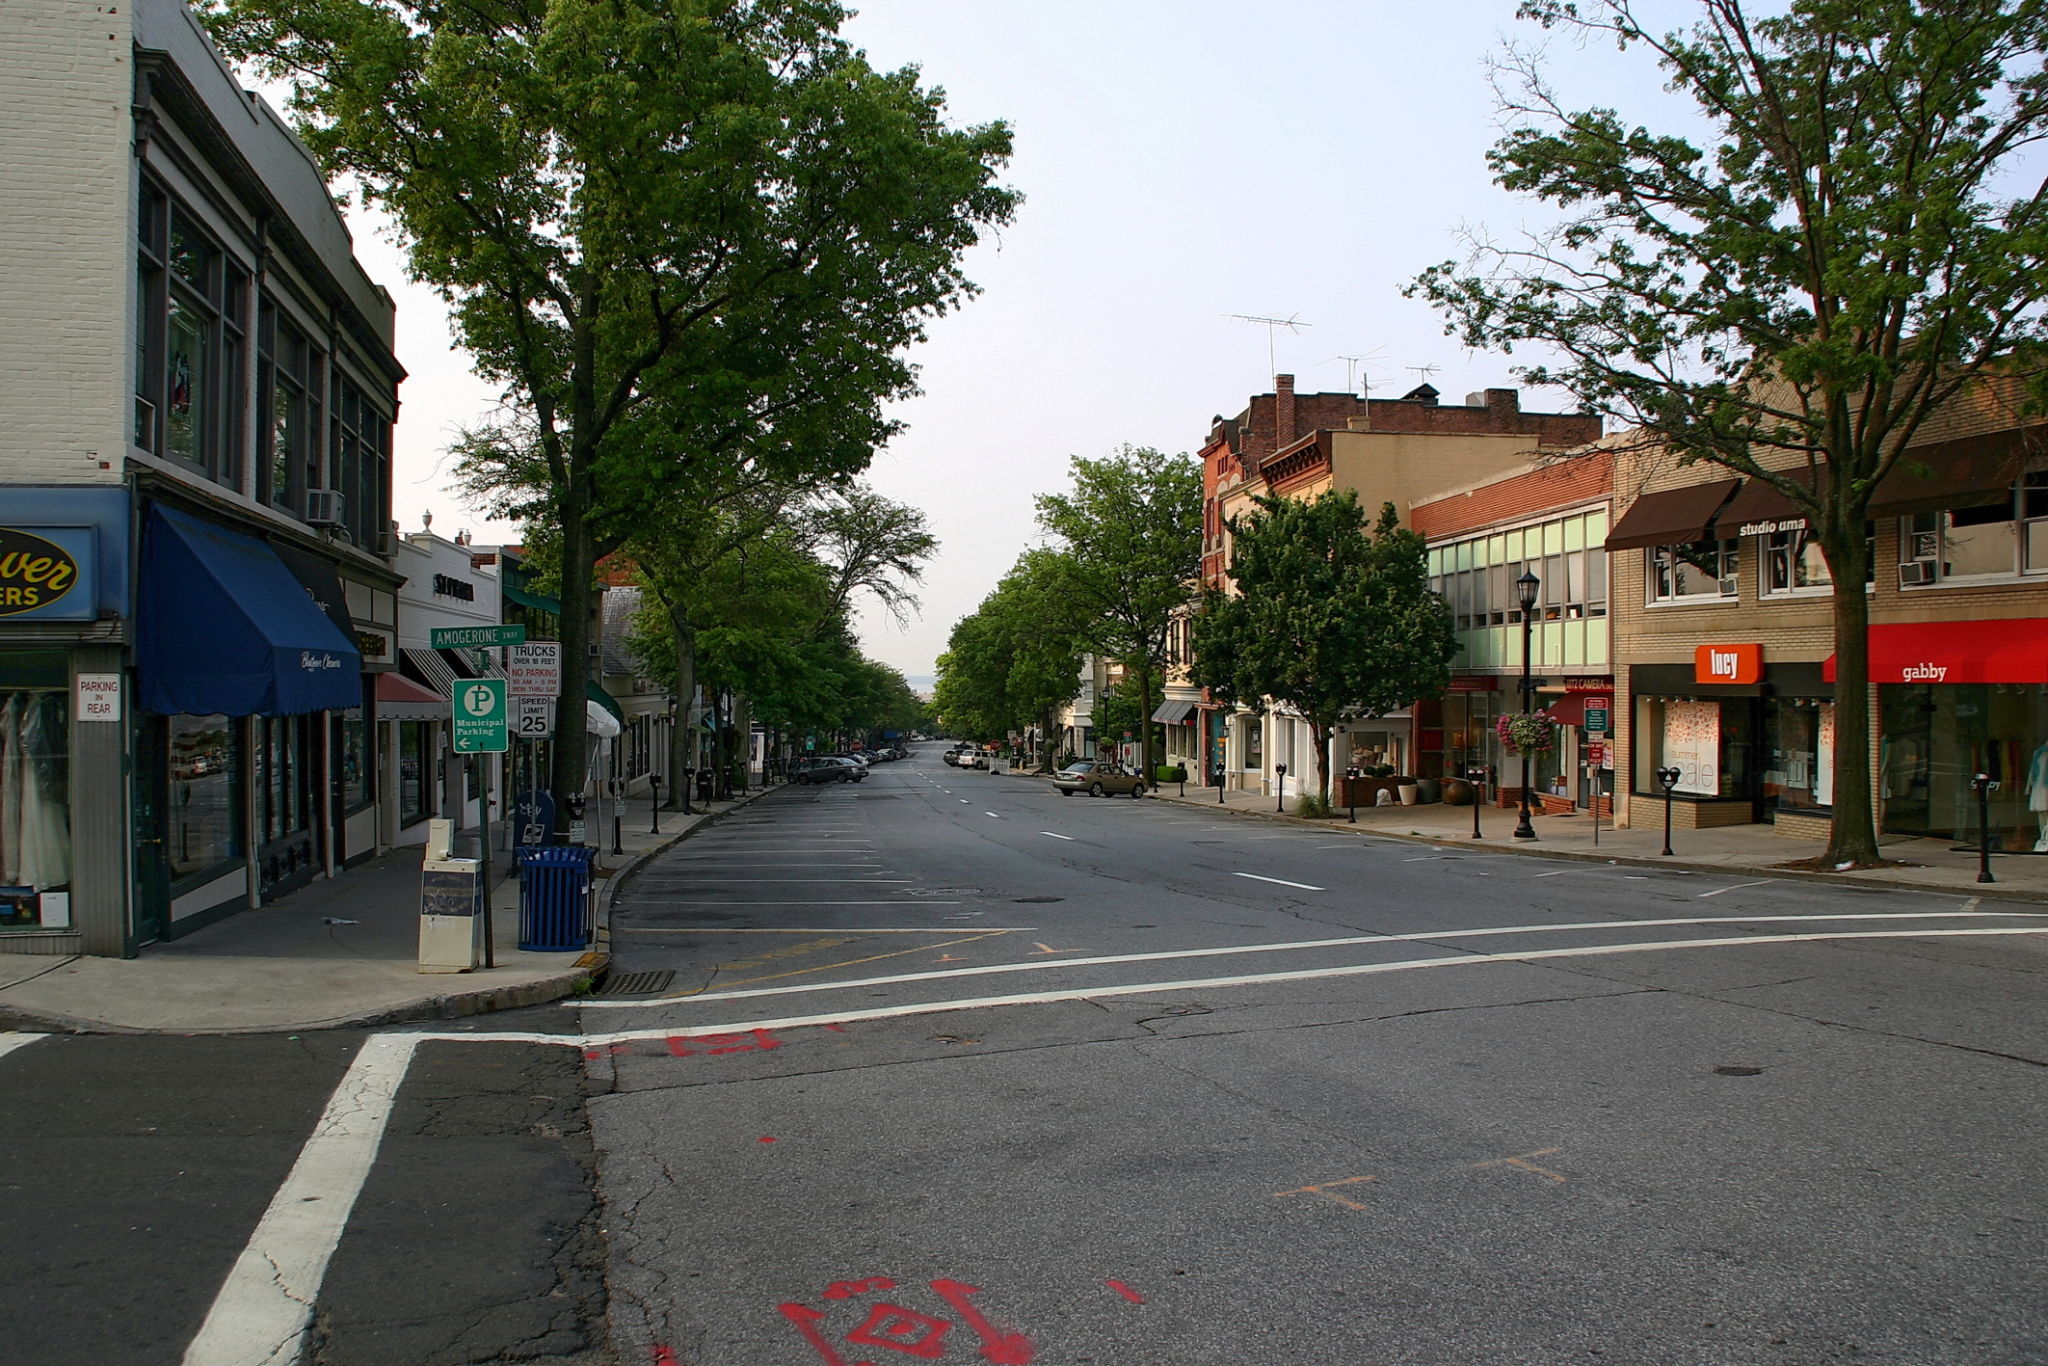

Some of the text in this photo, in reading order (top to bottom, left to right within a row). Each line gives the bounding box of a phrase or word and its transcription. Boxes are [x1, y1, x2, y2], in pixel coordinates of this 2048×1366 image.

[1739, 518, 1806, 537] studio uma
[436, 629, 499, 645] AMOGERONE
[513, 646, 556, 657] TRUCKS
[1710, 648, 1738, 680] lucy
[512, 668, 558, 677] NO PARKING
[1902, 662, 1948, 682] gabby
[80, 681, 118, 692] PARKING
[1578, 678, 1605, 690] CAMERA
[87, 703, 111, 714] REAR
[456, 719, 505, 728] Municipal
[522, 716, 546, 733] 25
[457, 727, 494, 736] Parking
[1671, 750, 1700, 760] summer
